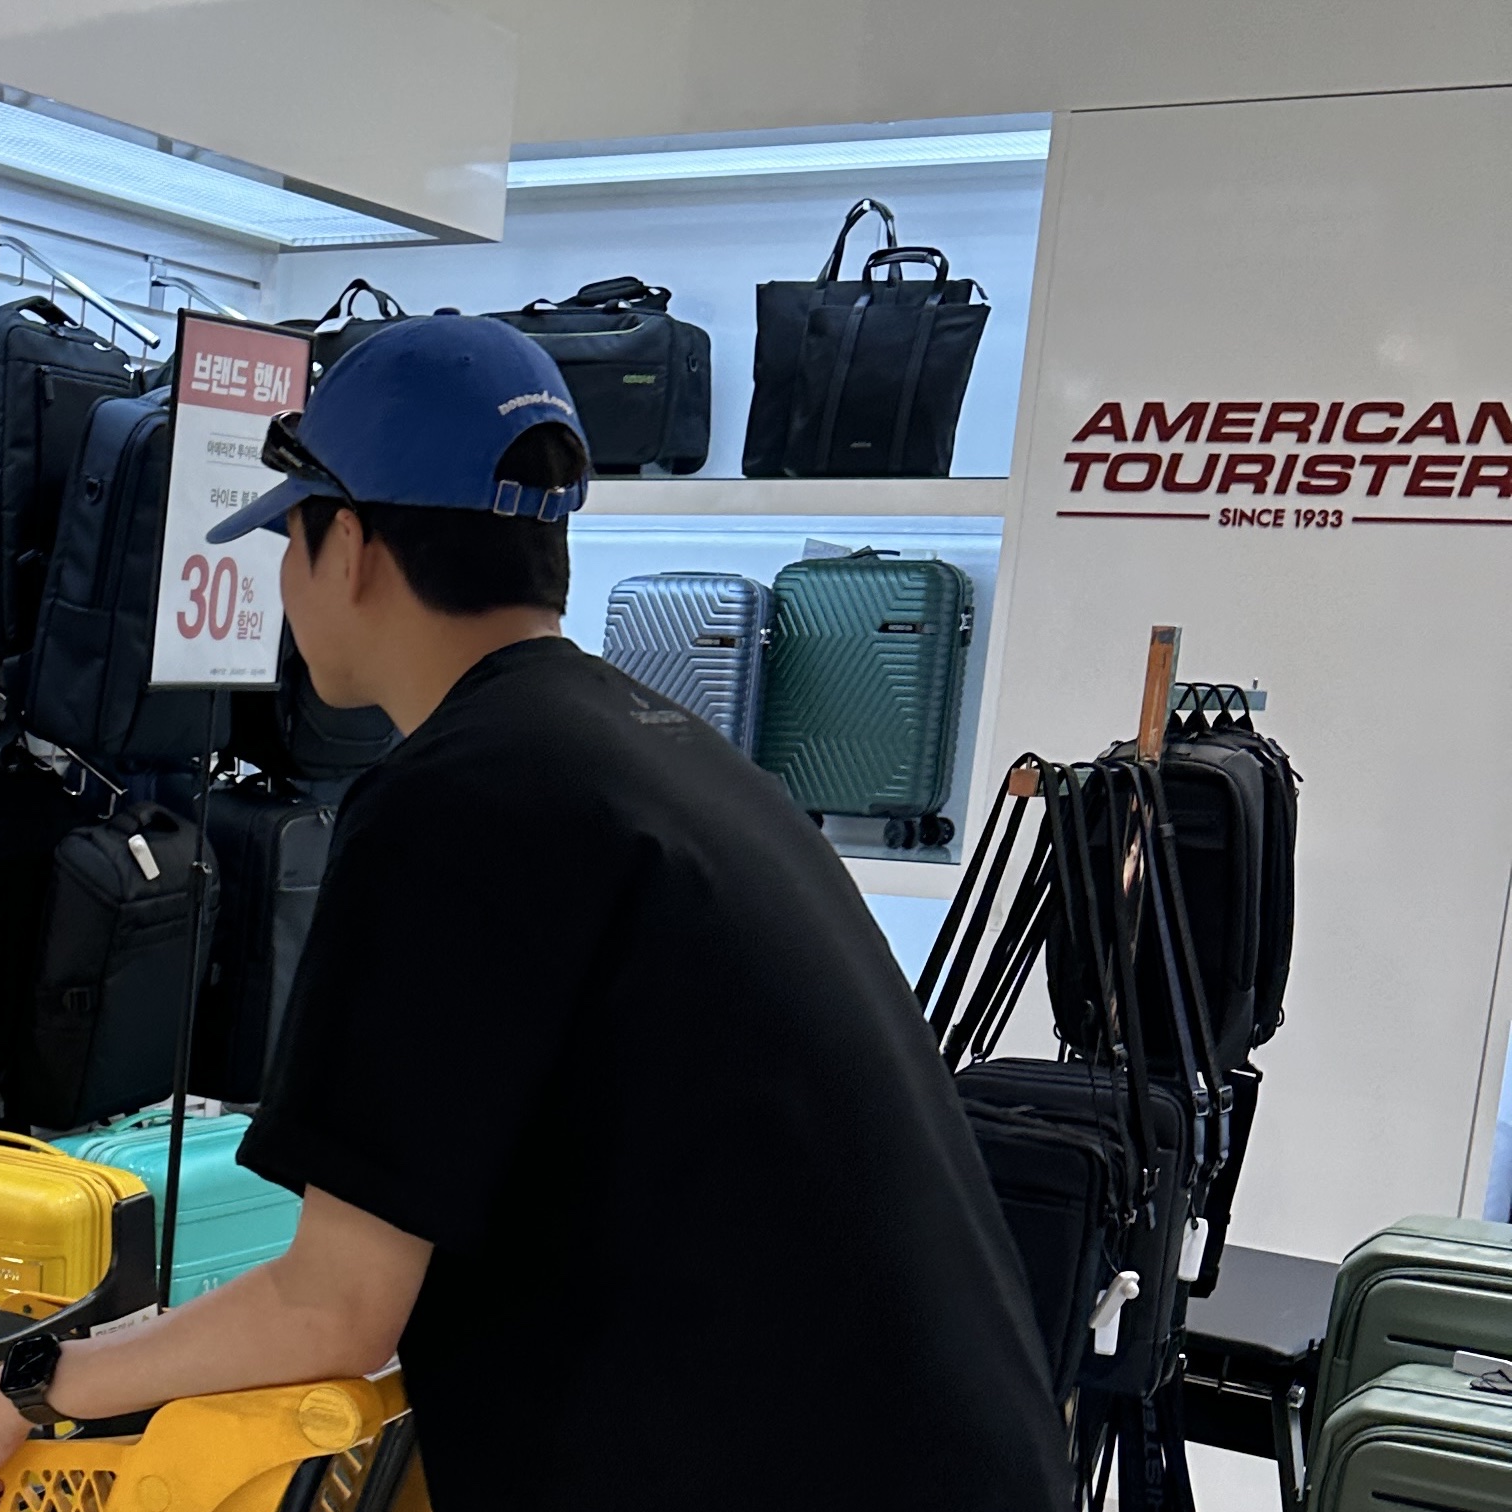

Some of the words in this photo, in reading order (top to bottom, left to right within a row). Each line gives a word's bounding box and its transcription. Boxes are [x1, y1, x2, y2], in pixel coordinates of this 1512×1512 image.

[191, 352, 250, 397] 브랜드
[253, 361, 291, 405] 행사
[1071, 402, 1512, 444] AMERICAN
[1064, 452, 1512, 498] TOURISTER
[210, 487, 238, 508] 라이트
[1218, 508, 1285, 529] SINCE
[1294, 509, 1343, 529] 1933
[237, 610, 265, 641] 할인
